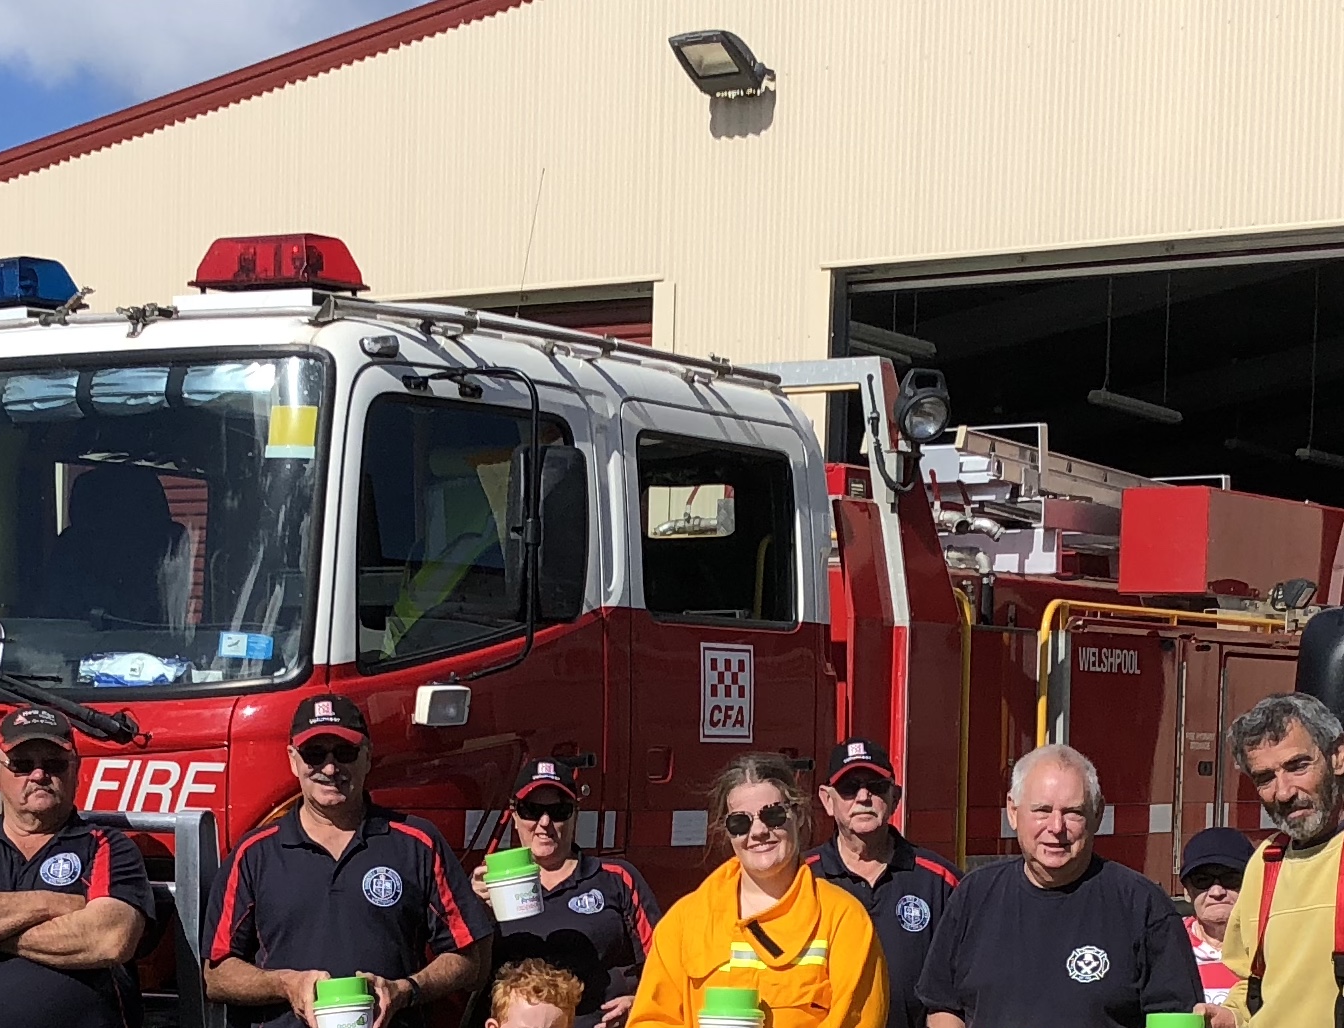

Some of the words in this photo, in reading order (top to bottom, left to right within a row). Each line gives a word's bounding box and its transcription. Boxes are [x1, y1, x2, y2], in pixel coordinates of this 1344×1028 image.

[1078, 646, 1141, 675] WELSHPOOL
[709, 704, 745, 729] CFA
[83, 759, 227, 814] FIRE
